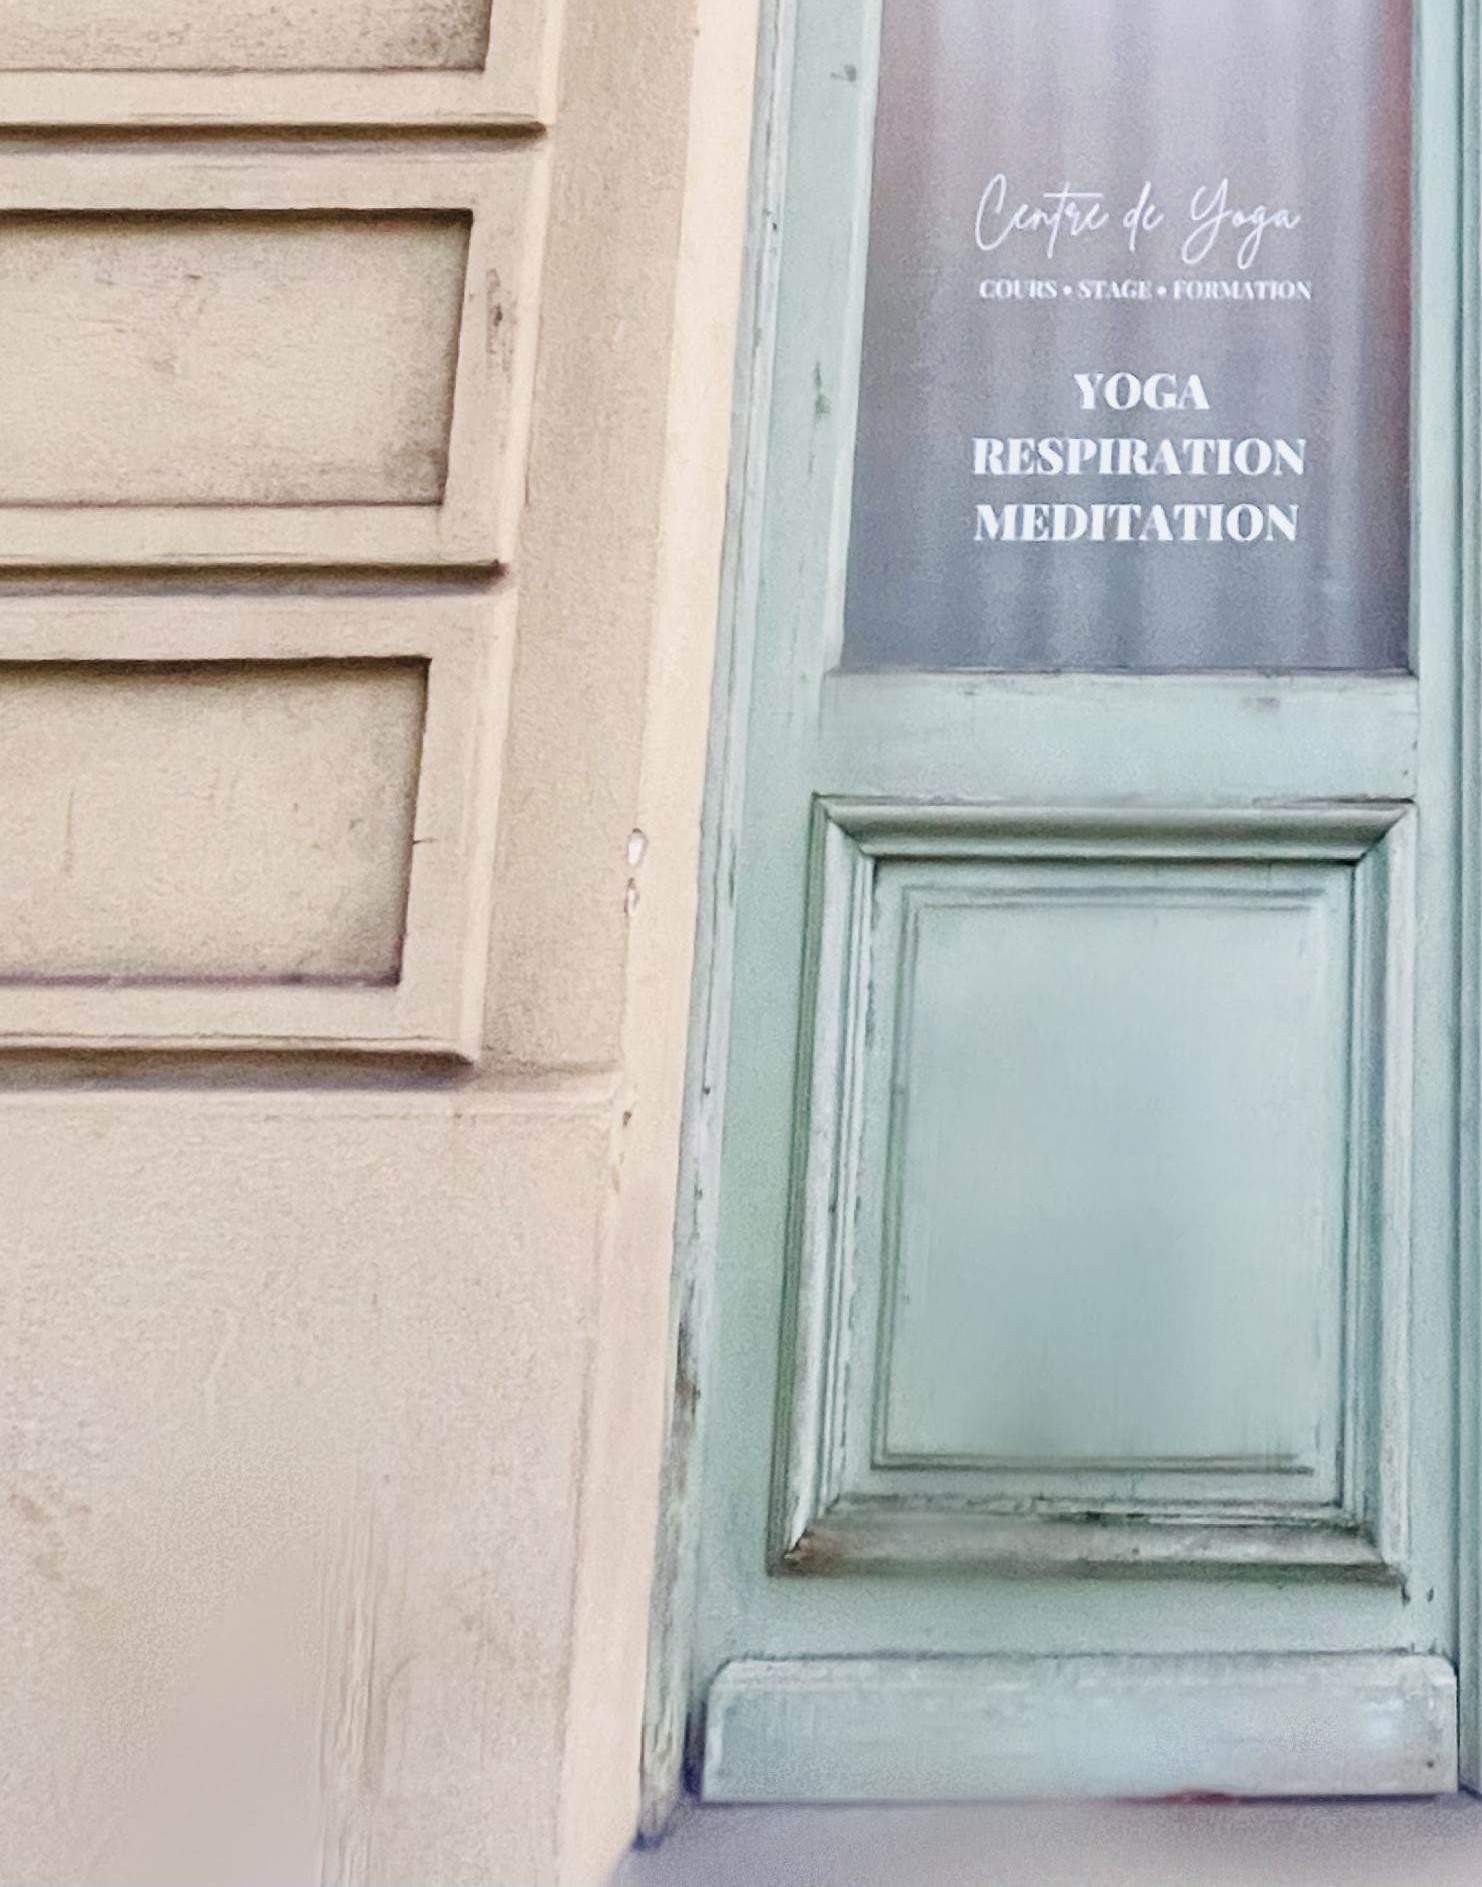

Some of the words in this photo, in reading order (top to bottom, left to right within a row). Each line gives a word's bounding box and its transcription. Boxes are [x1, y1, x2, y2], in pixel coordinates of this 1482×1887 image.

[975, 173, 1110, 259] Centre
[1122, 181, 1165, 252] de
[1181, 178, 1301, 270] Yoga
[979, 280, 1057, 300] COURS
[1078, 280, 1152, 300] STAGE
[1173, 280, 1312, 301] FORMATION
[1073, 373, 1210, 410] YOGA
[971, 437, 1307, 475] RESPIRATION
[973, 503, 1300, 542] MEDITATION
